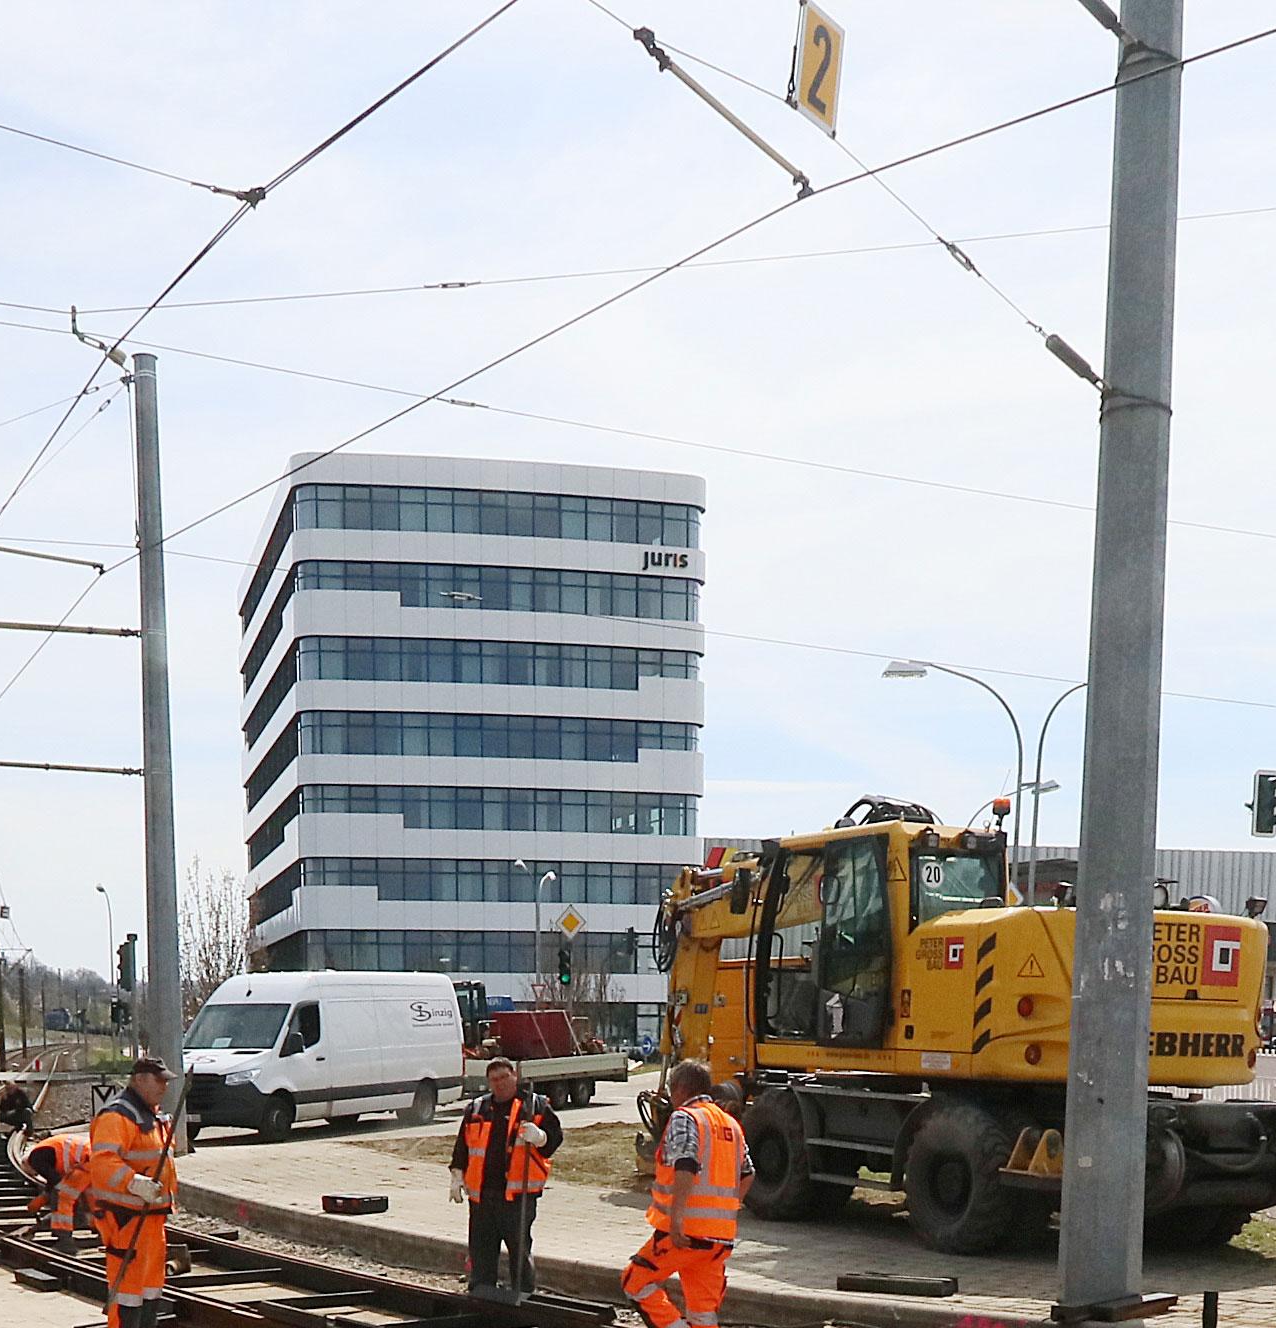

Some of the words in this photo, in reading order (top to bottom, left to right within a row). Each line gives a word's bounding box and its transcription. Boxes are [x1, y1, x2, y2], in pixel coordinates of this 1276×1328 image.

[807, 25, 832, 116] 2
[642, 551, 688, 571] juris
[925, 866, 941, 883] 20
[1153, 922, 1200, 942] ETER
[1152, 945, 1199, 964] OSS
[1156, 965, 1197, 985] BAU
[1149, 1032, 1245, 1058] BHERR
